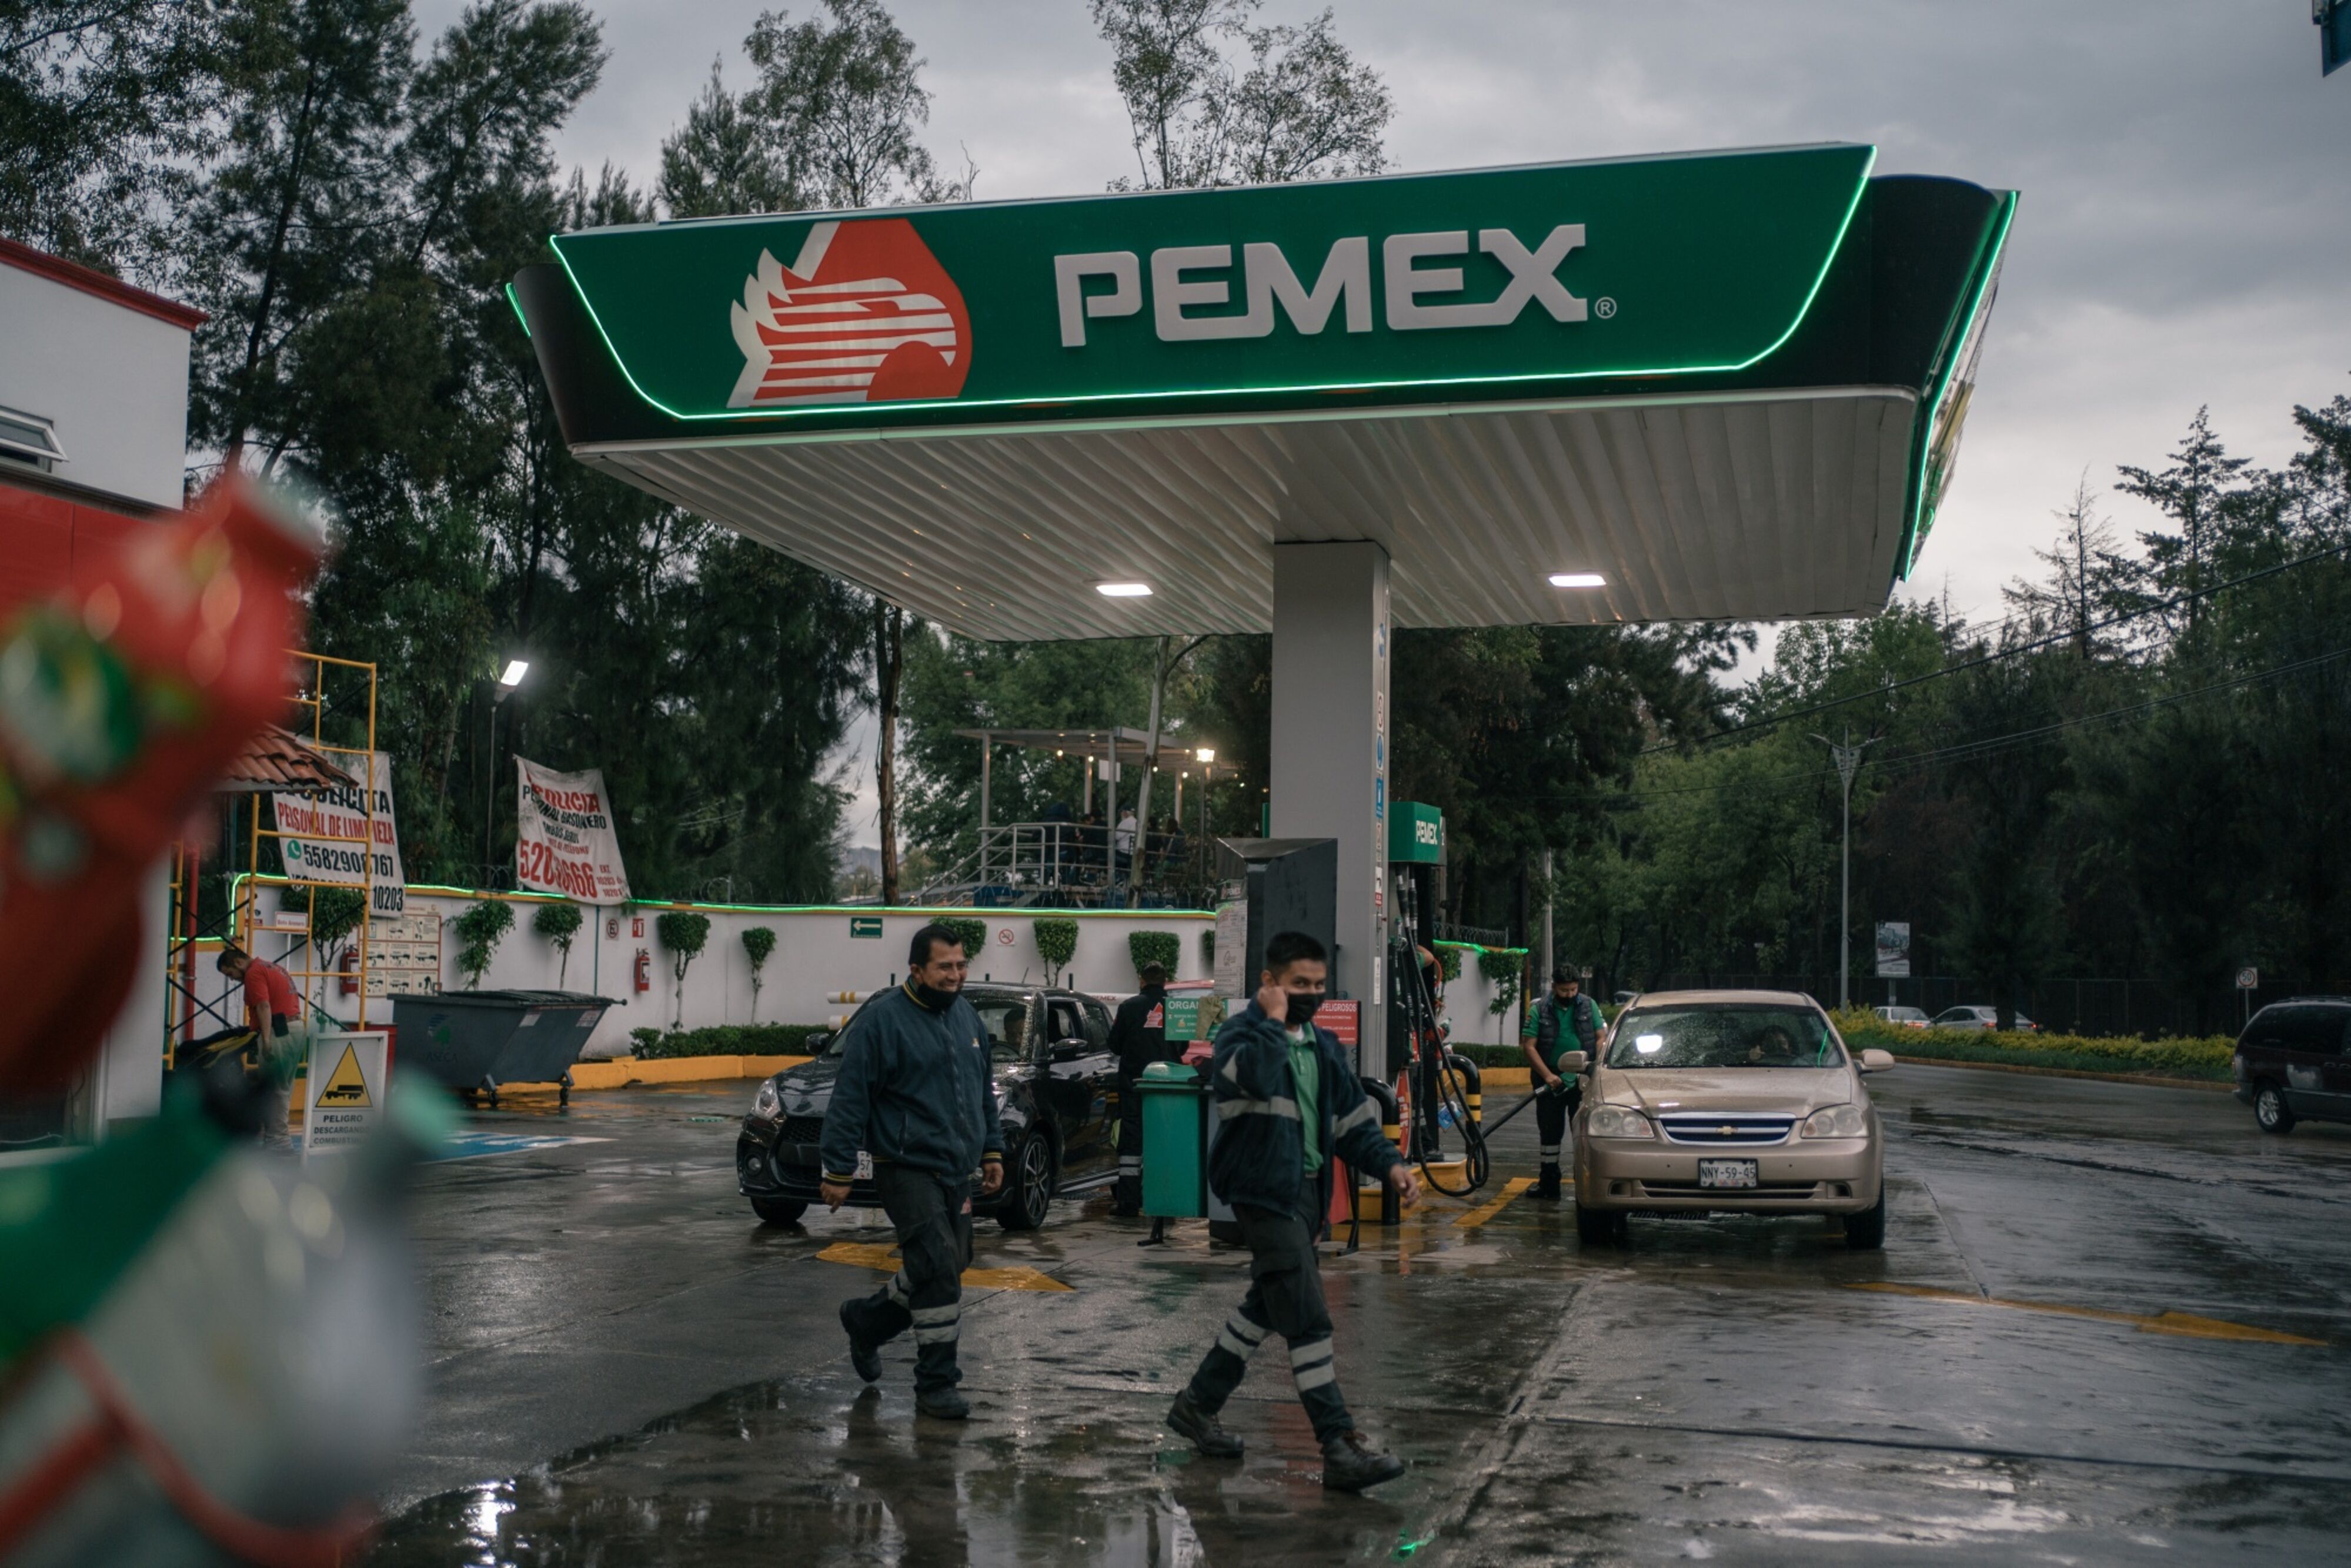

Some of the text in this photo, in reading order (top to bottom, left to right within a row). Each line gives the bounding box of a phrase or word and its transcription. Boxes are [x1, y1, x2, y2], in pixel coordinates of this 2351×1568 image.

[1054, 223, 1588, 347] PEMEX
[328, 815, 342, 837] DE
[343, 817, 395, 845] LIMIEZA
[1416, 820, 1438, 845] PEMEX
[373, 885, 403, 911] 10203
[2242, 972, 2252, 981] 50
[323, 1114, 363, 1123] PELIGRO
[1701, 1166, 1756, 1179] NNY-59-45
